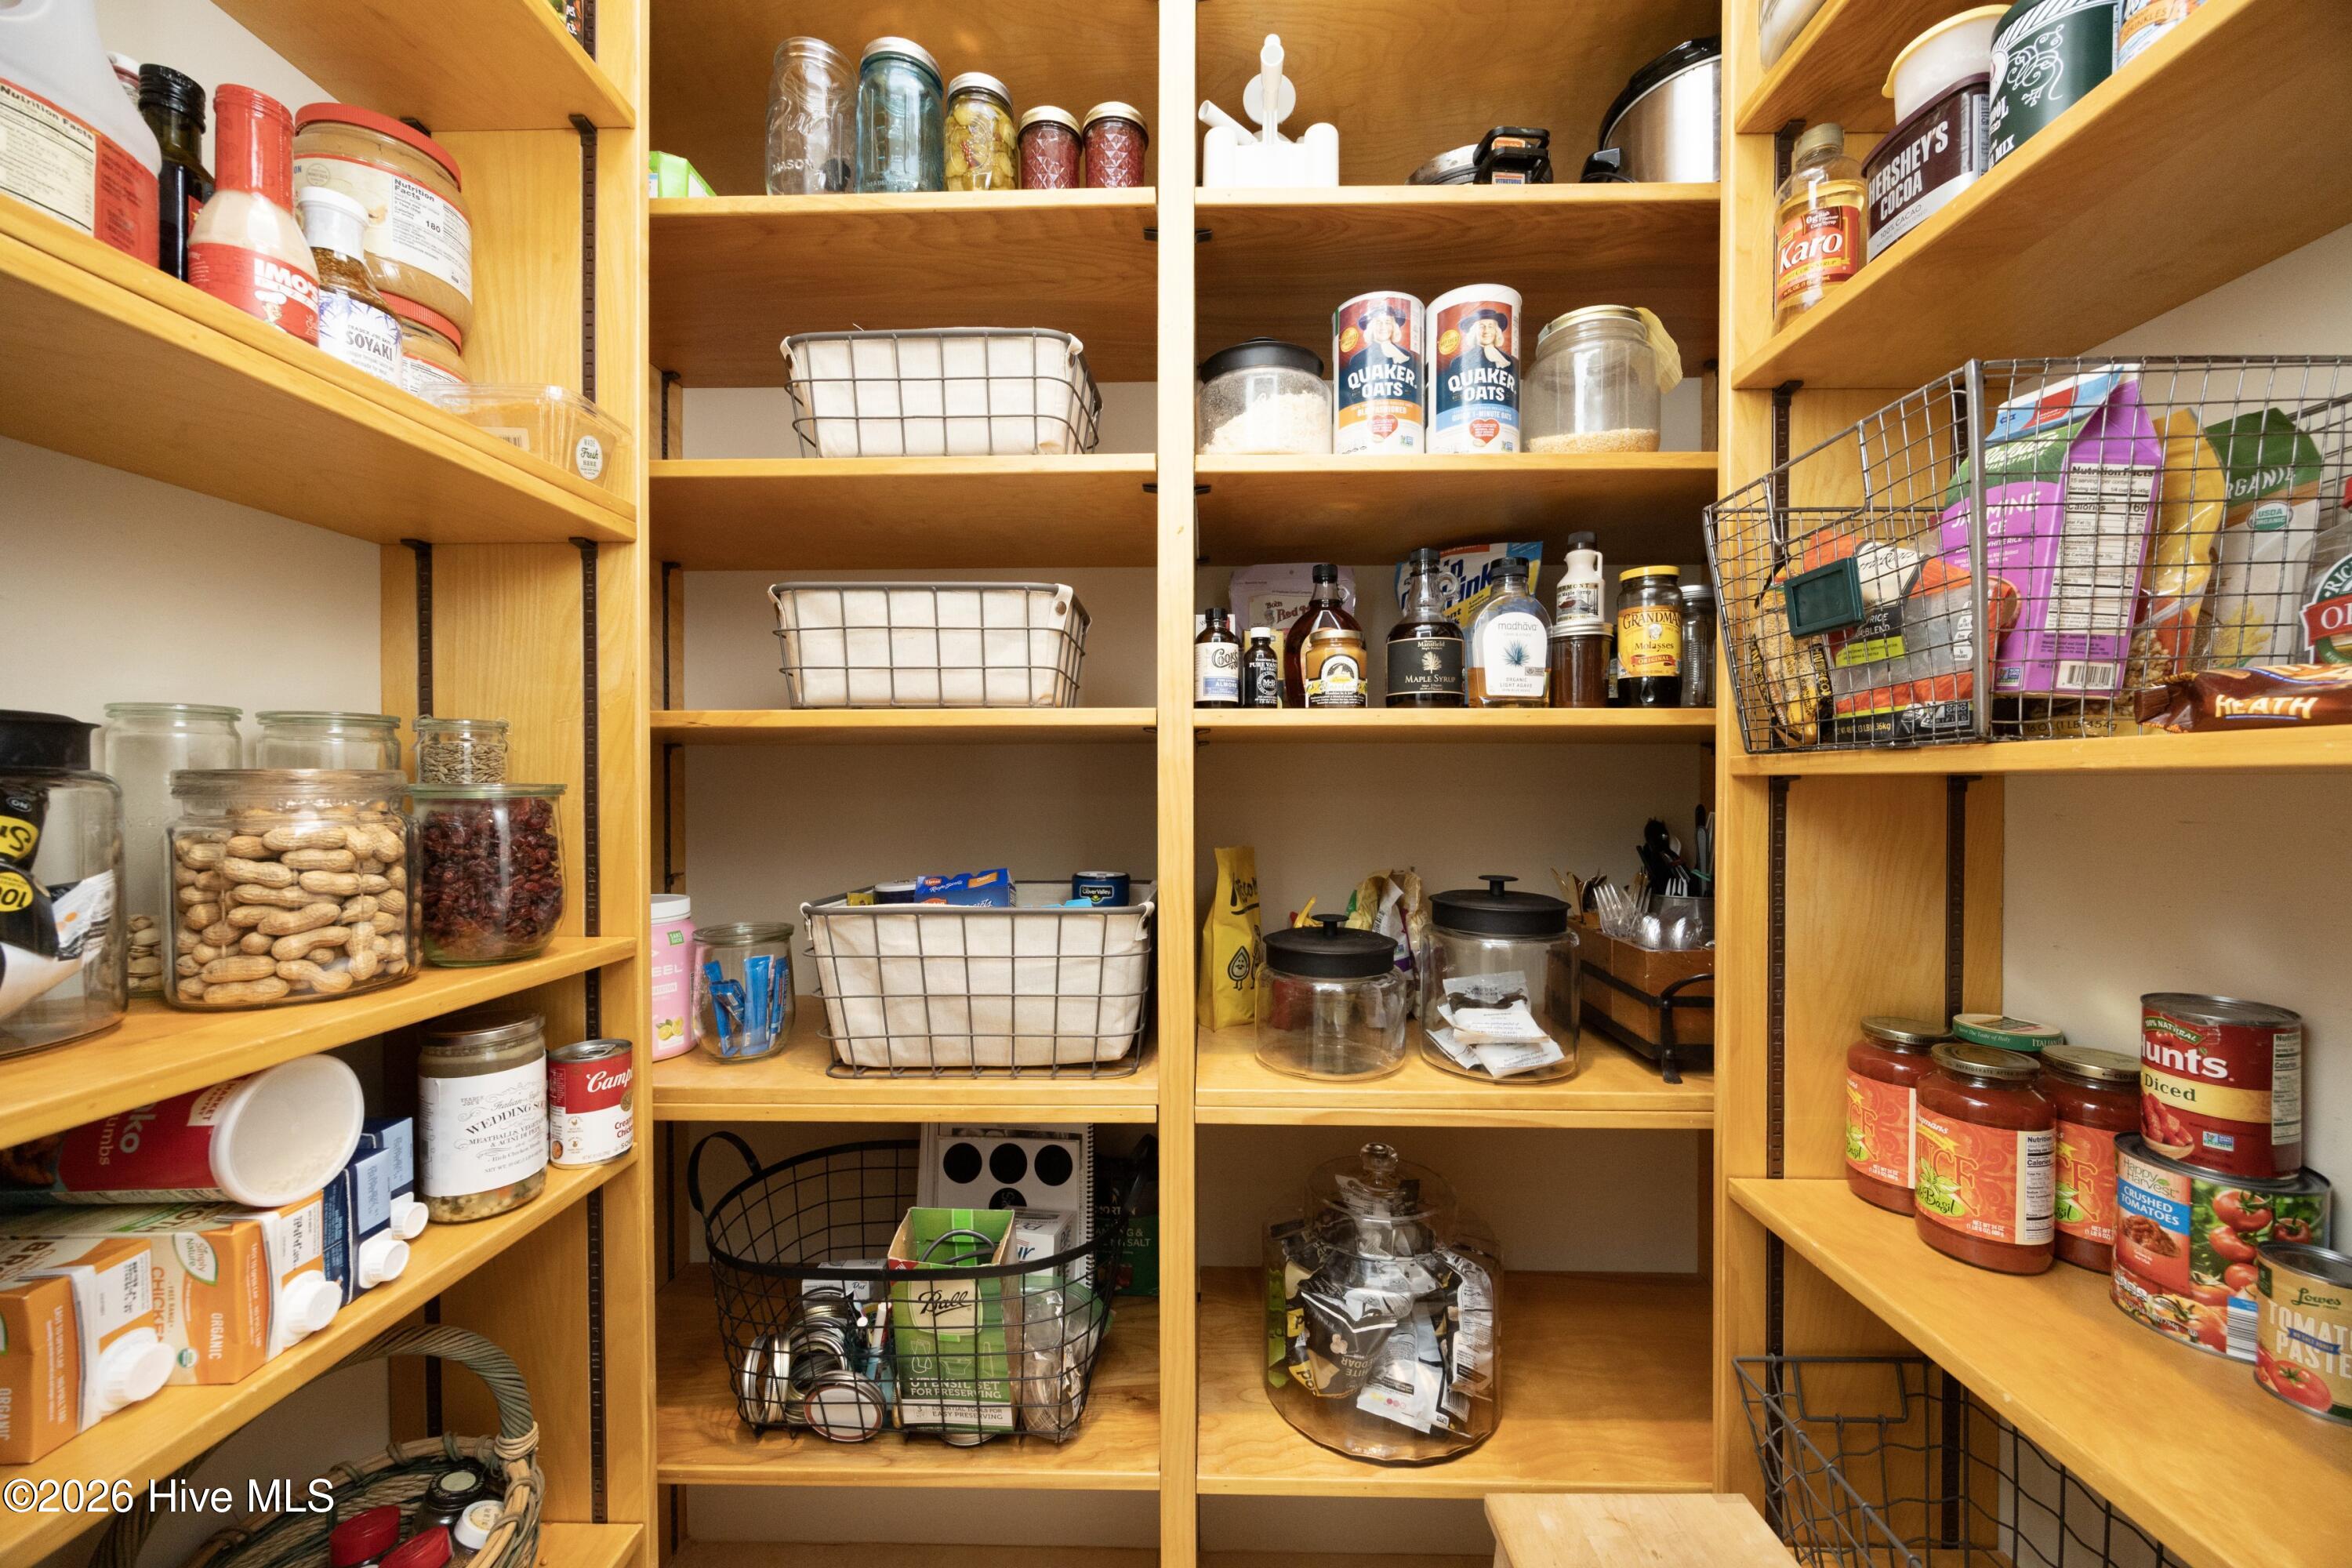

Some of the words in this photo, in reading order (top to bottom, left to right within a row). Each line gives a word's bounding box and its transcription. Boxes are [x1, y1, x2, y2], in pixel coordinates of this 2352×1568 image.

[0, 85, 59, 119] Nutrition
[63, 118, 93, 141] Facts
[1995, 134, 2015, 162] MIX
[1868, 121, 1949, 209] HERSHEY'S
[394, 178, 435, 202] Nutrition
[394, 186, 421, 201] Facts
[1880, 170, 1922, 221] COCOA
[426, 220, 441, 233] 180
[1895, 204, 1922, 227] CACAO
[1780, 234, 1842, 275] Karo
[346, 332, 393, 361] SOYAKI
[1348, 363, 1416, 390] QUAKER
[1447, 368, 1516, 393] QUAKER
[1361, 382, 1403, 398] OATS
[1464, 386, 1505, 401] OATS
[580, 448, 599, 460] Fresh
[2072, 466, 2122, 477] Nutrition
[2257, 508, 2283, 517] USDA
[1276, 606, 1298, 623] Red
[1634, 641, 1675, 652] Molasses
[1638, 655, 1669, 664] ORIGINAL
[1405, 675, 1432, 684] MAPLE
[1434, 674, 1456, 683] SYRUP
[2215, 694, 2319, 719] HEATH
[1978, 1029, 1991, 1039] Taste
[2158, 1020, 2197, 1042] NATURAL
[1955, 1063, 1994, 1075] REFRIGERATE
[2144, 1073, 2197, 1102] Diced
[466, 1104, 531, 1134] WEDDING
[2124, 1157, 2159, 1182] Happy
[2127, 1171, 2175, 1199] Harvest
[1922, 1187, 1955, 1215] Basil
[2121, 1192, 2180, 1226] TOMATOES
[2124, 1185, 2173, 1213] CRUSHED
[185, 1237, 196, 1267] Nature
[1127, 1239, 1152, 1248] SALT
[196, 1243, 207, 1272] Simply
[917, 1290, 973, 1316] Ball
[2291, 1287, 2342, 1307] Lowes
[209, 1312, 224, 1360] ORGANIC
[910, 1388, 932, 1397] FOR
[934, 1388, 1003, 1399] PRESERVING
[2, 1388, 12, 1440] ORGANIC
